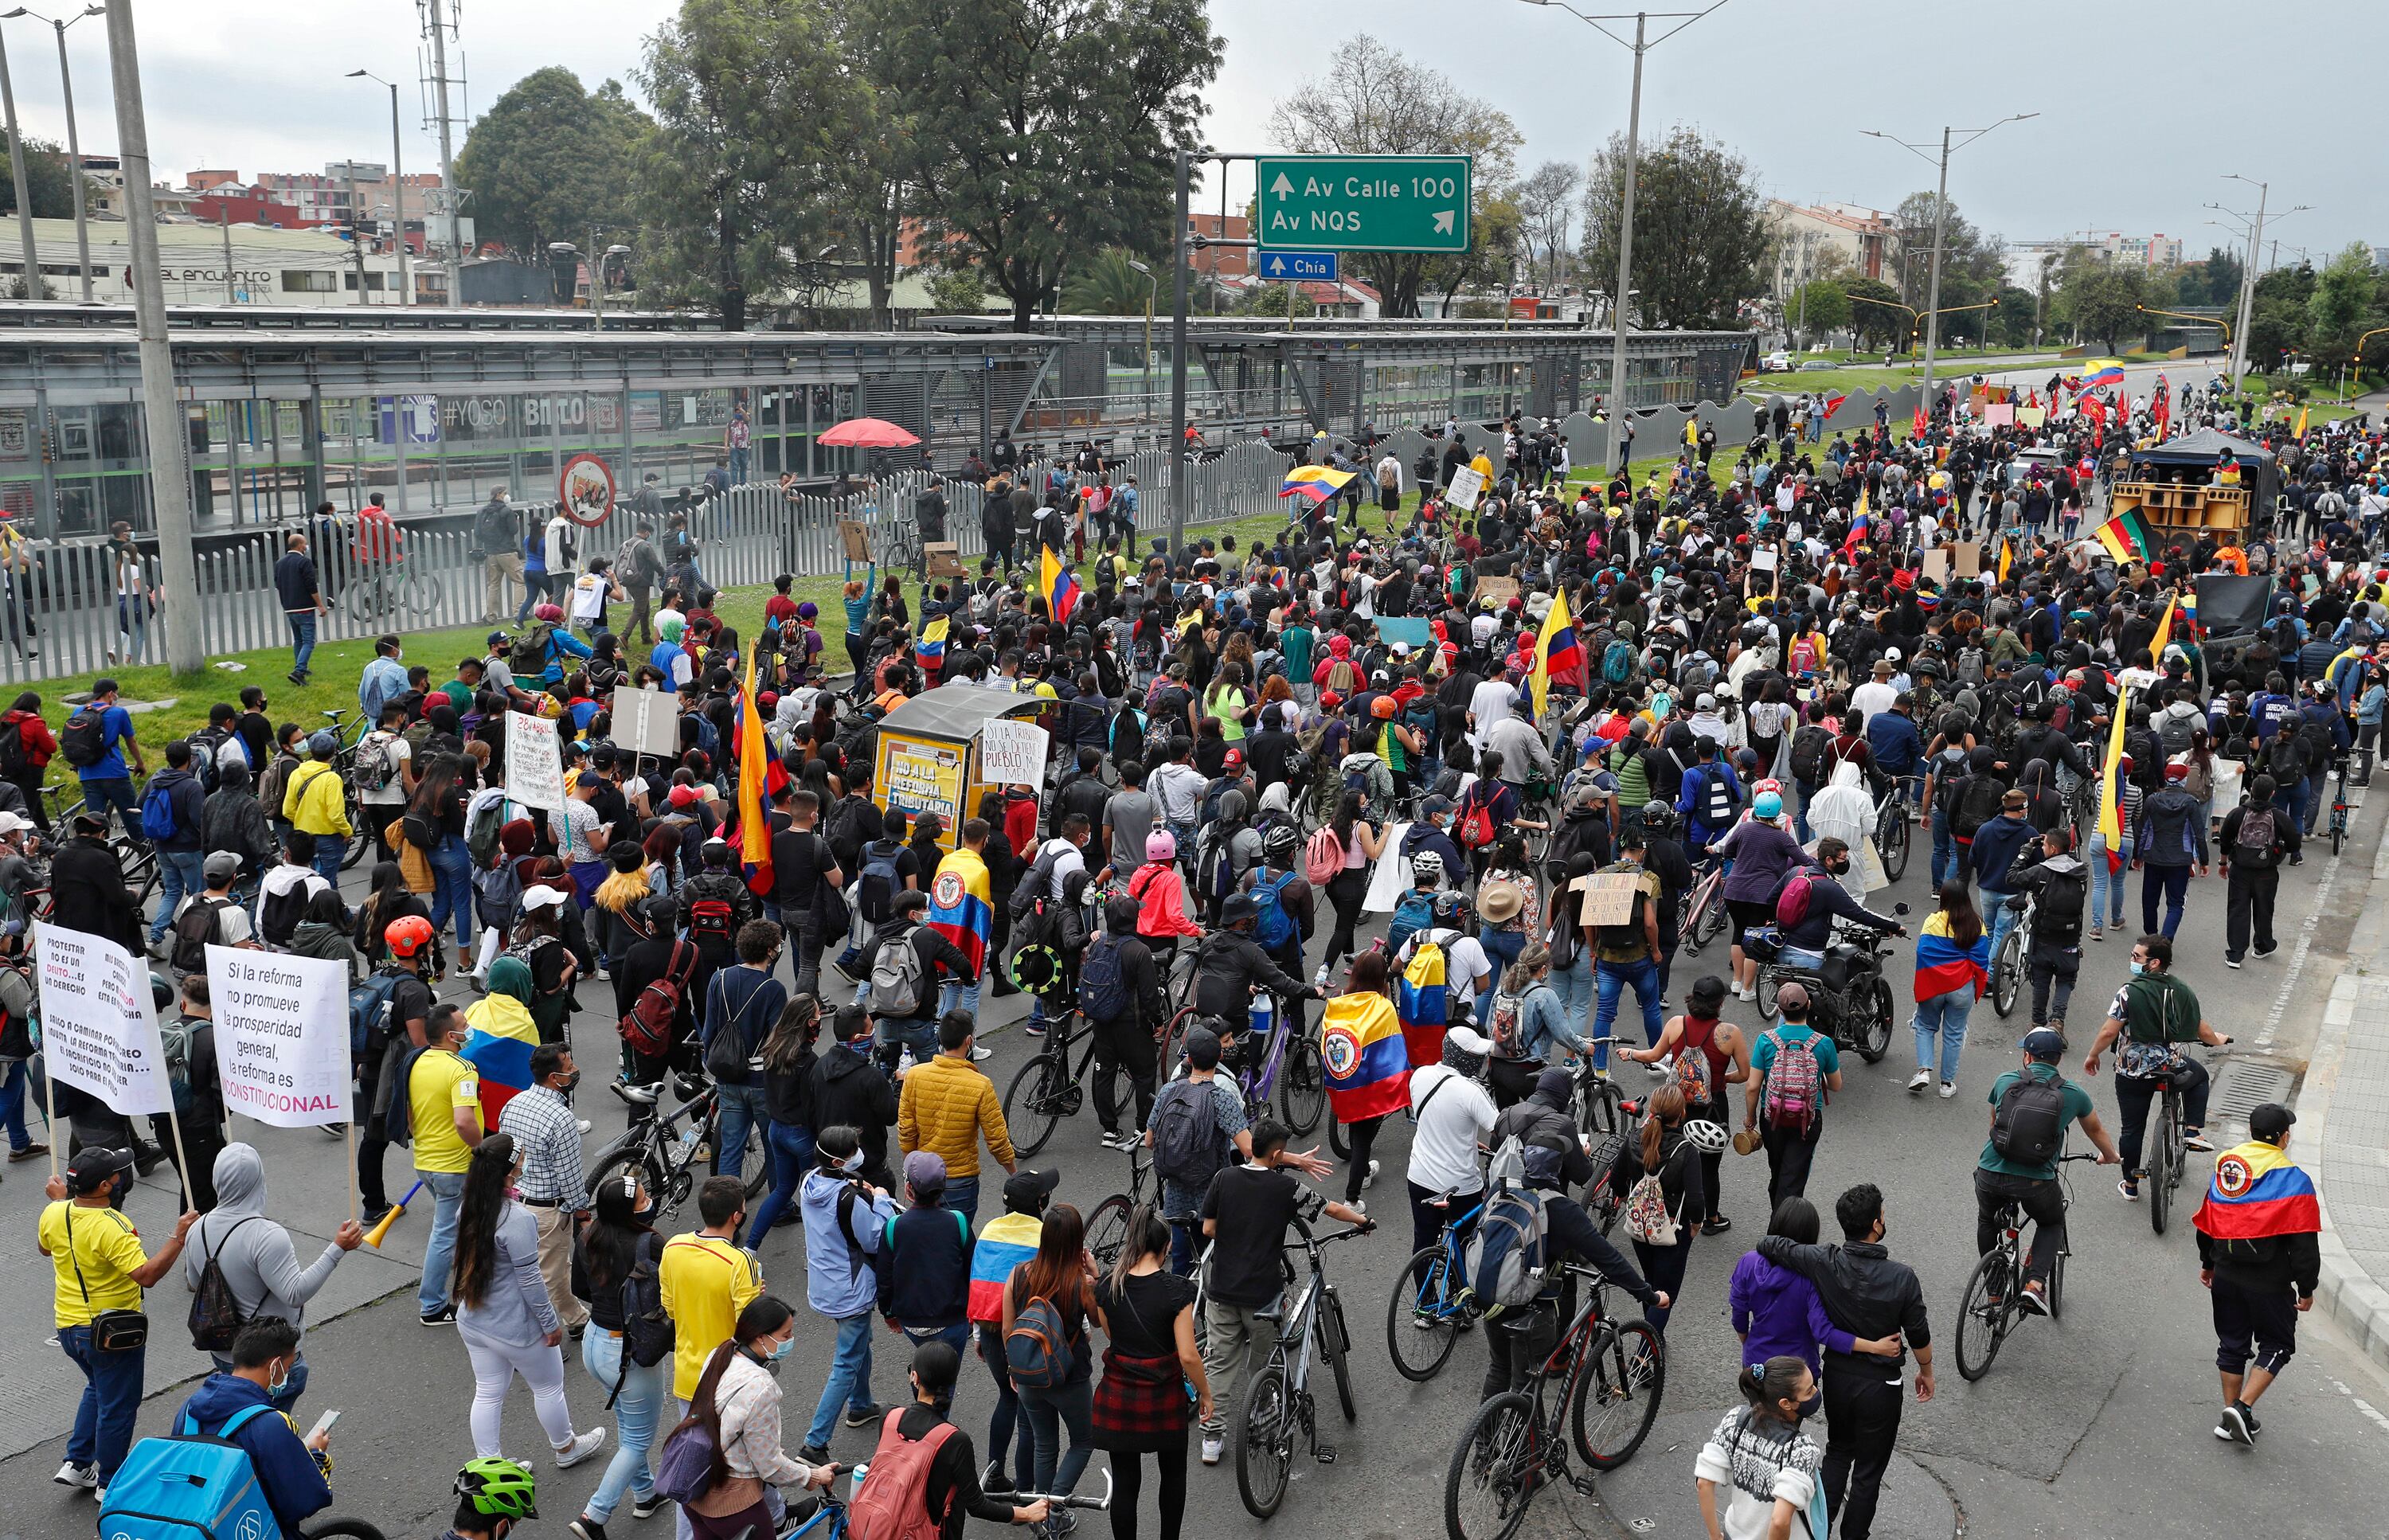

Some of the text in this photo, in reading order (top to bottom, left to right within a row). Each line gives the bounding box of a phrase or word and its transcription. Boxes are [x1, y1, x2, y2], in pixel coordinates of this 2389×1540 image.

[1304, 176, 1456, 198] Av Calle 100
[1271, 209, 1362, 232] Av NQS
[1294, 260, 1326, 274] Chía
[988, 358, 994, 368] B
[518, 717, 553, 734] 28 ABRIL
[987, 721, 997, 739] SI
[1000, 727, 1011, 740] LA
[985, 740, 996, 752] NO
[998, 740, 1008, 752] SE
[986, 752, 1022, 768] PUEBLO
[897, 761, 936, 782] NO A LA
[893, 776, 940, 799] REFORMA
[892, 791, 952, 817] TRIBUTARIA
[1586, 874, 1637, 890] MARCHO
[1591, 913, 1622, 924] SENTADO
[47, 937, 85, 955] PROTESTAR
[51, 952, 80, 967] NO ES UN
[45, 975, 86, 995] UN DERECHO
[228, 962, 303, 988] Si la reforma
[102, 979, 115, 992] PERO
[98, 991, 110, 1003] ESTA
[227, 989, 299, 1013] no promueve
[49, 1014, 65, 1029] SALGO
[67, 1021, 72, 1031] A
[73, 1023, 103, 1043] CAMINAR
[224, 1009, 302, 1038] la prosperidad
[1326, 1029, 1351, 1038] UBLICA
[48, 1026, 68, 1043] INJUSTA
[70, 1036, 77, 1047] LA
[78, 1039, 108, 1060] REFORMA
[237, 1040, 279, 1064] general,
[65, 1048, 101, 1069] SACRIFICIO
[103, 1061, 111, 1073] NO
[1095, 1062, 1101, 1071] S
[69, 1062, 84, 1077] SOLO
[86, 1069, 102, 1083] PARA
[229, 1057, 237, 1075] la
[237, 1061, 276, 1085] reforma
[278, 1073, 293, 1088] es
[221, 1076, 339, 1113] INCONSTITUCIONAL
[512, 1137, 522, 1153] NO
